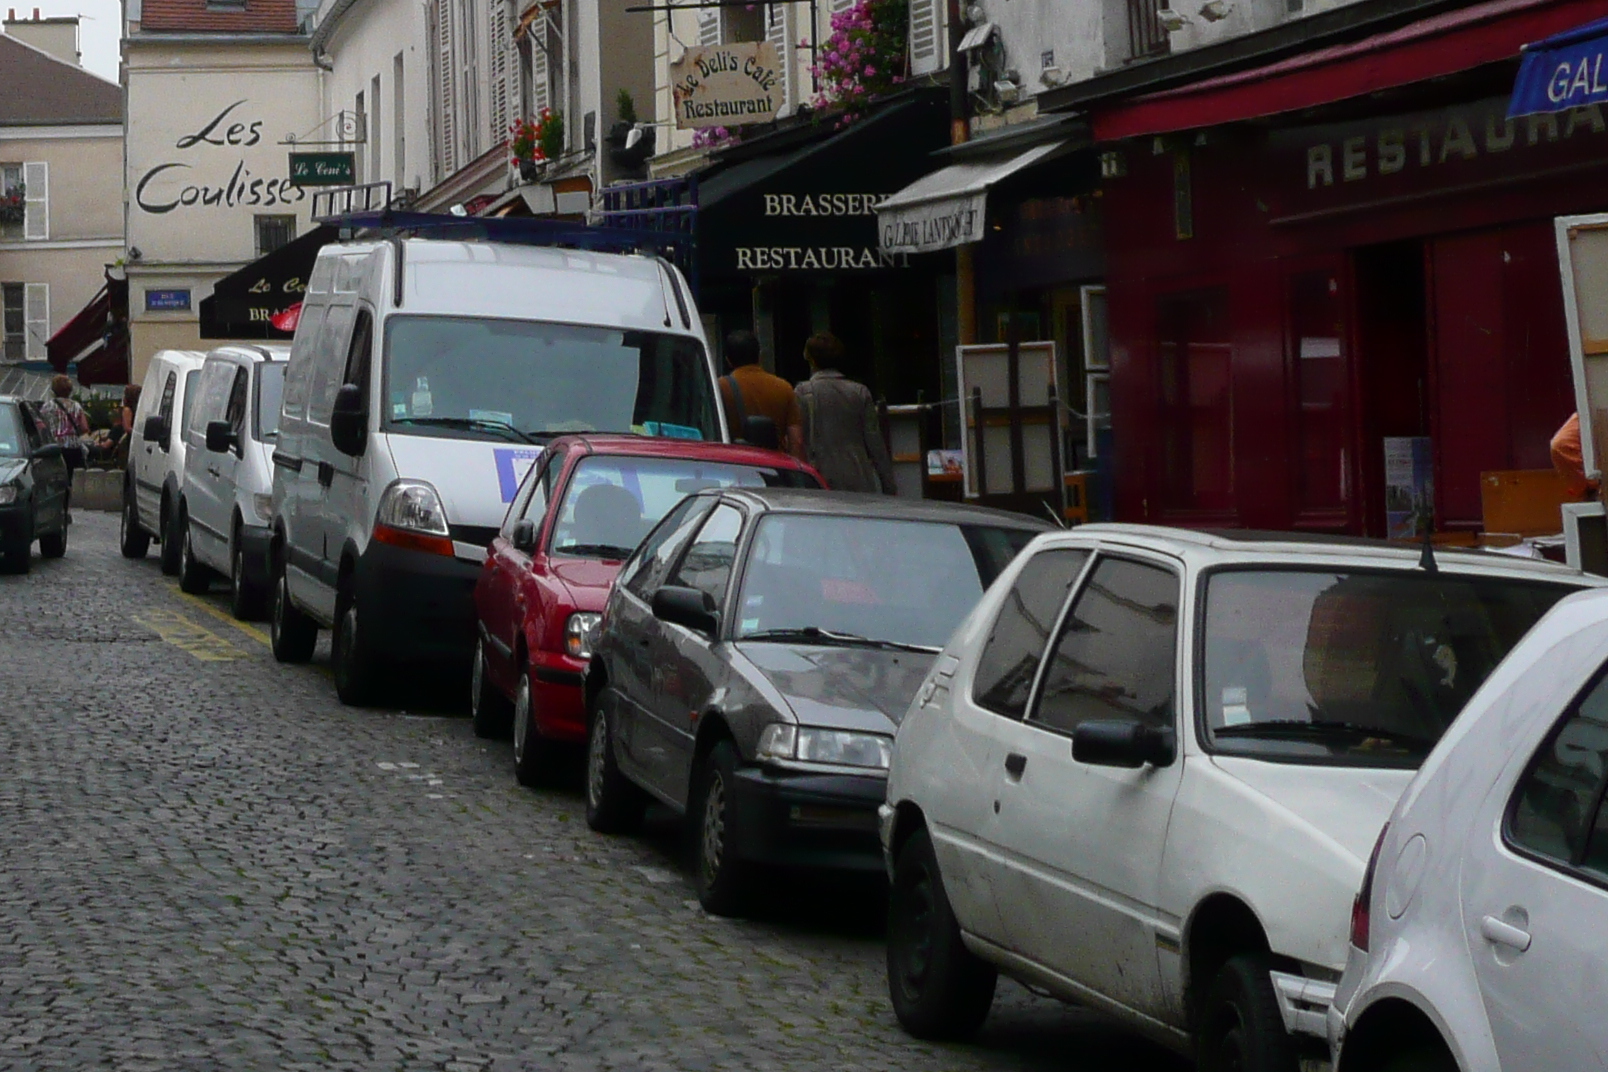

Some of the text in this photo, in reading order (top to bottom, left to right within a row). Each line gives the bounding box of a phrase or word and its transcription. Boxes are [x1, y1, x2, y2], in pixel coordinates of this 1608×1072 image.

[694, 51, 739, 78] Deli's
[683, 95, 773, 119] Restaurant
[176, 98, 263, 149] Les
[136, 158, 306, 214] Coulisses
[736, 247, 911, 270] RESTAURANT
